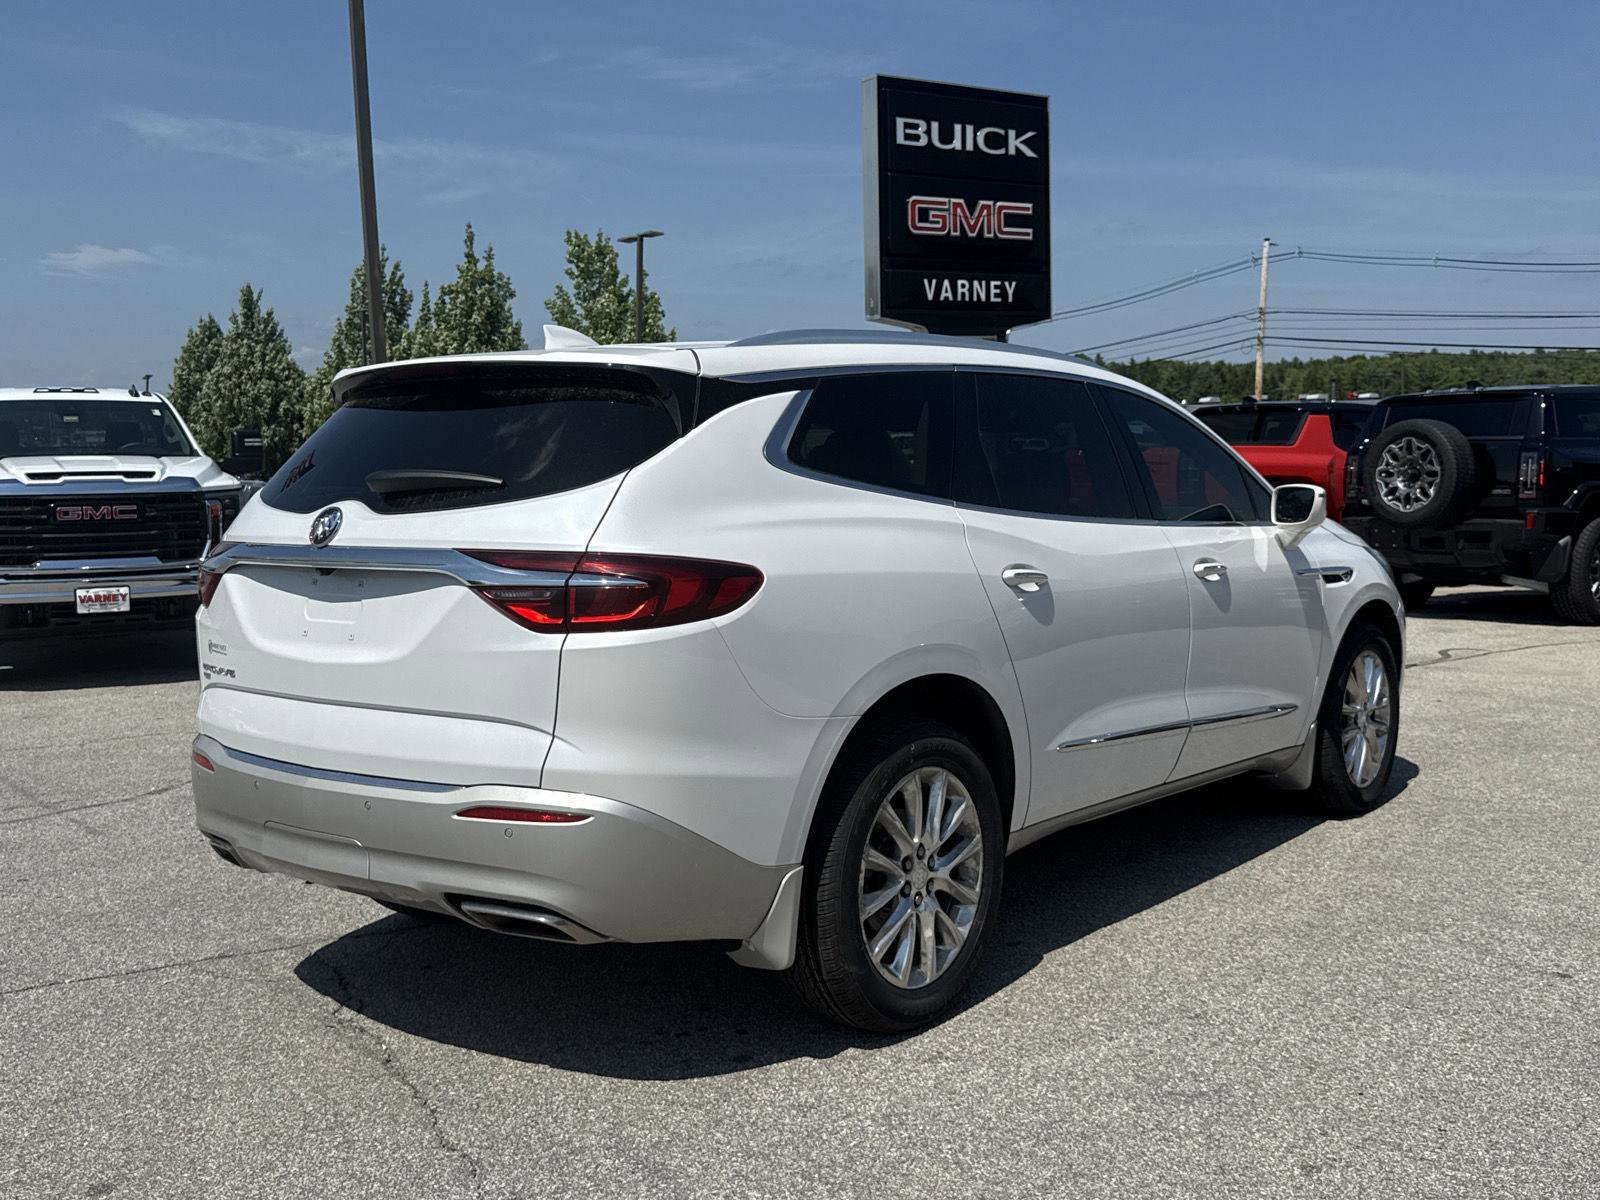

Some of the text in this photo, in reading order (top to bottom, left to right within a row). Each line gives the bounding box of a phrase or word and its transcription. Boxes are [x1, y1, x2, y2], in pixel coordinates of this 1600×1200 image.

[895, 116, 1039, 158] BUICK
[906, 195, 1034, 240] GMC
[923, 278, 1017, 303] VARNEY
[56, 505, 138, 520] GMC
[78, 593, 129, 604] VARNEY
